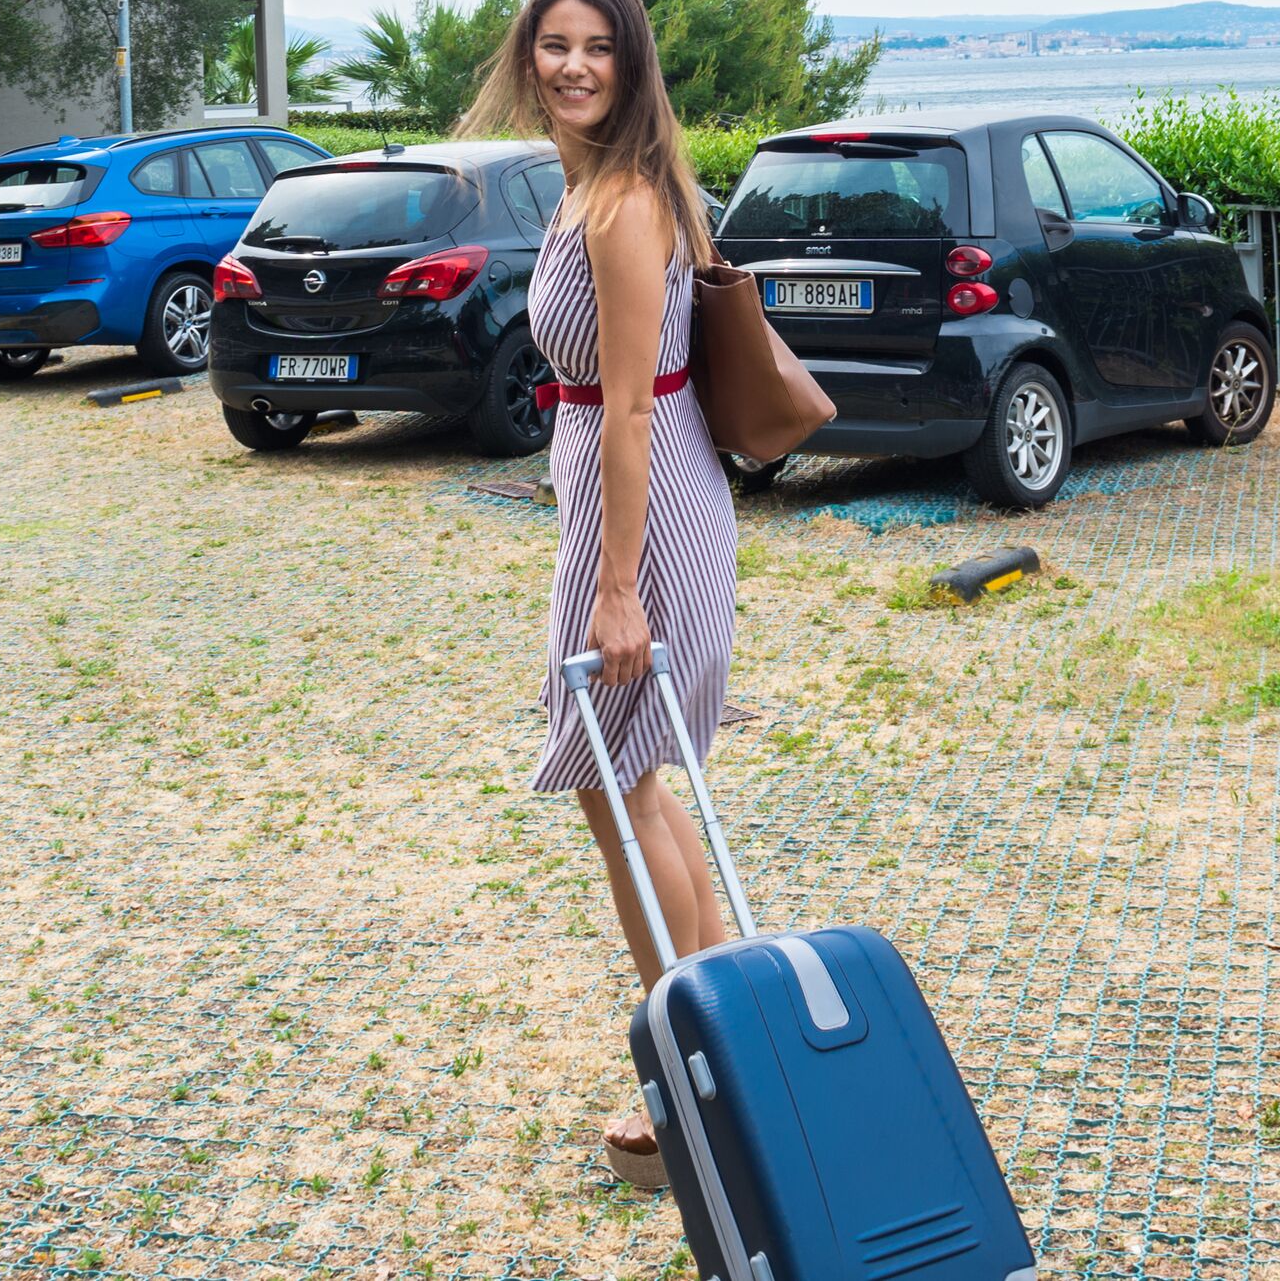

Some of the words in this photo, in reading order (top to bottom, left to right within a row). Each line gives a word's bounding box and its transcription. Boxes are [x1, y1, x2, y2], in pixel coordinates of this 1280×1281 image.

[805, 245, 832, 255] smart
[777, 282, 797, 305] DT
[804, 283, 860, 307] 889AH
[901, 306, 923, 315] mhd
